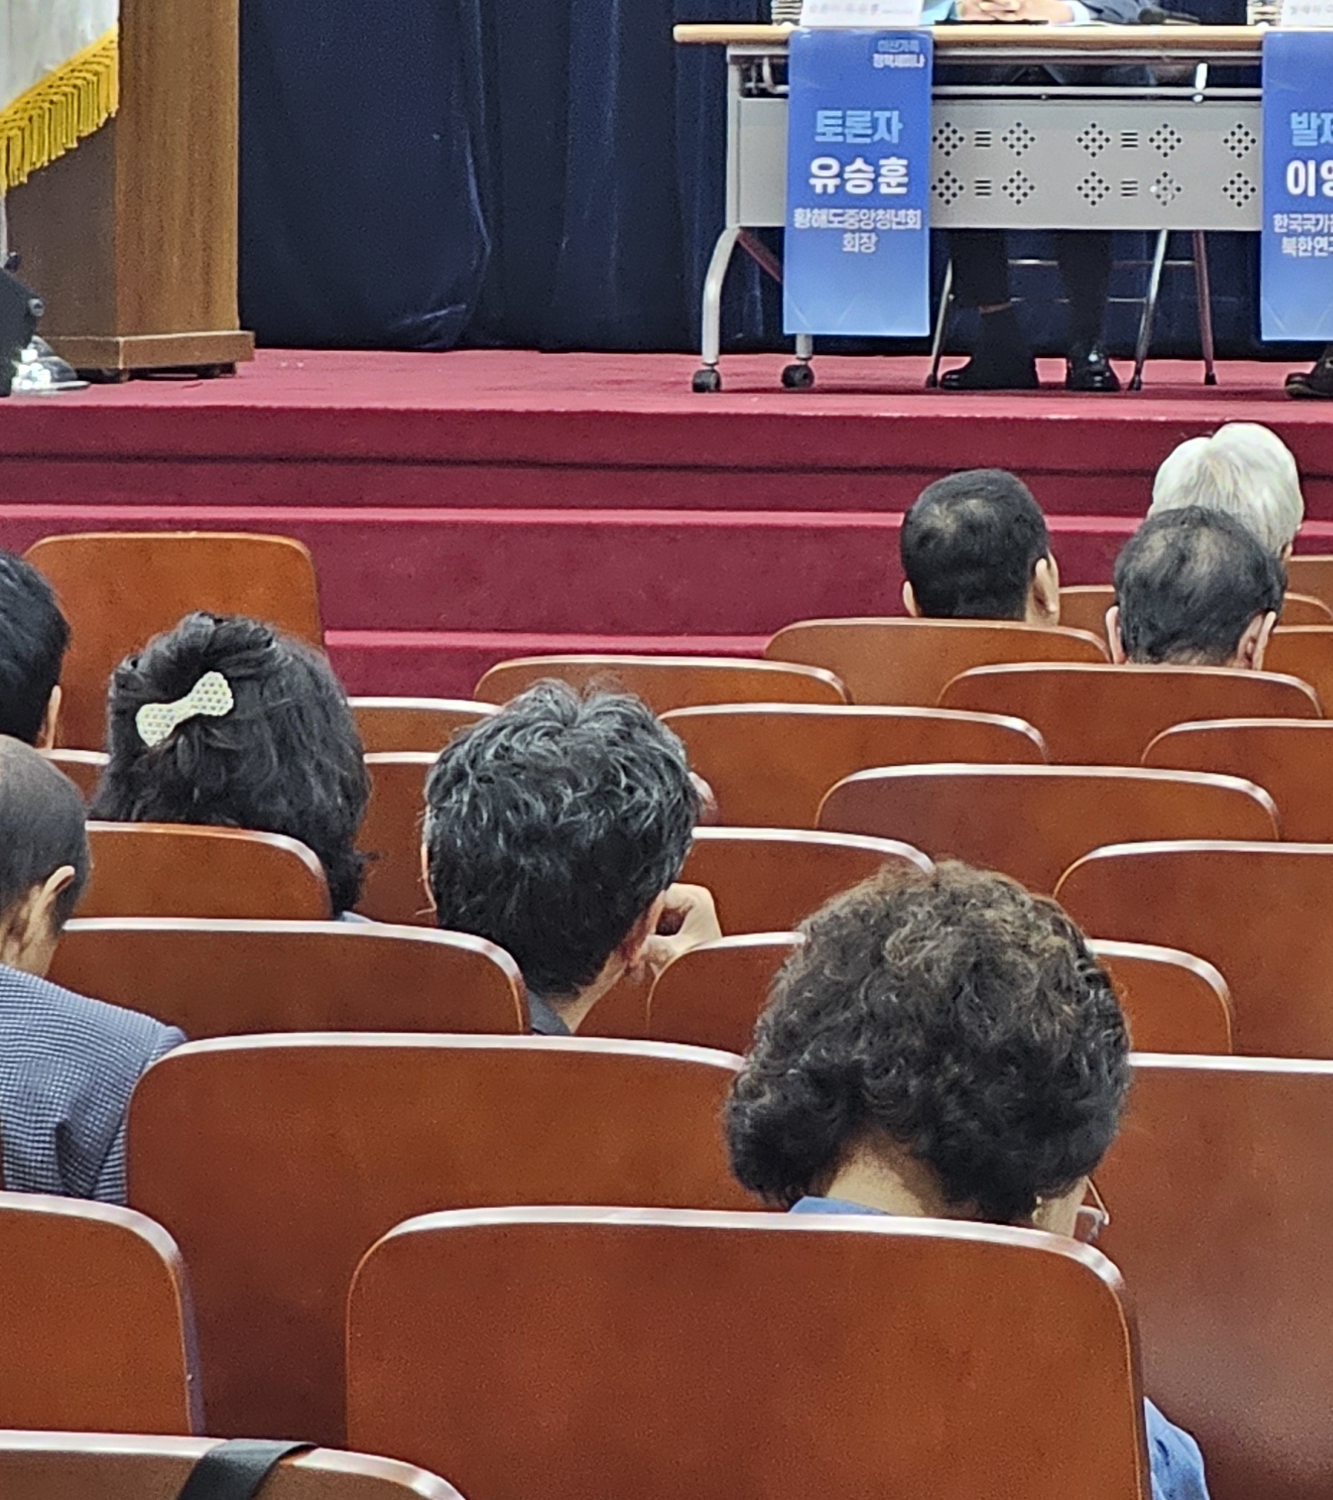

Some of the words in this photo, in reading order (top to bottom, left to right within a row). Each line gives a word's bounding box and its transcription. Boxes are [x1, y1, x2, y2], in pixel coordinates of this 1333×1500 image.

[813, 109, 904, 144] 토론자
[808, 156, 909, 195] 유승훈
[842, 231, 879, 254] 회장
